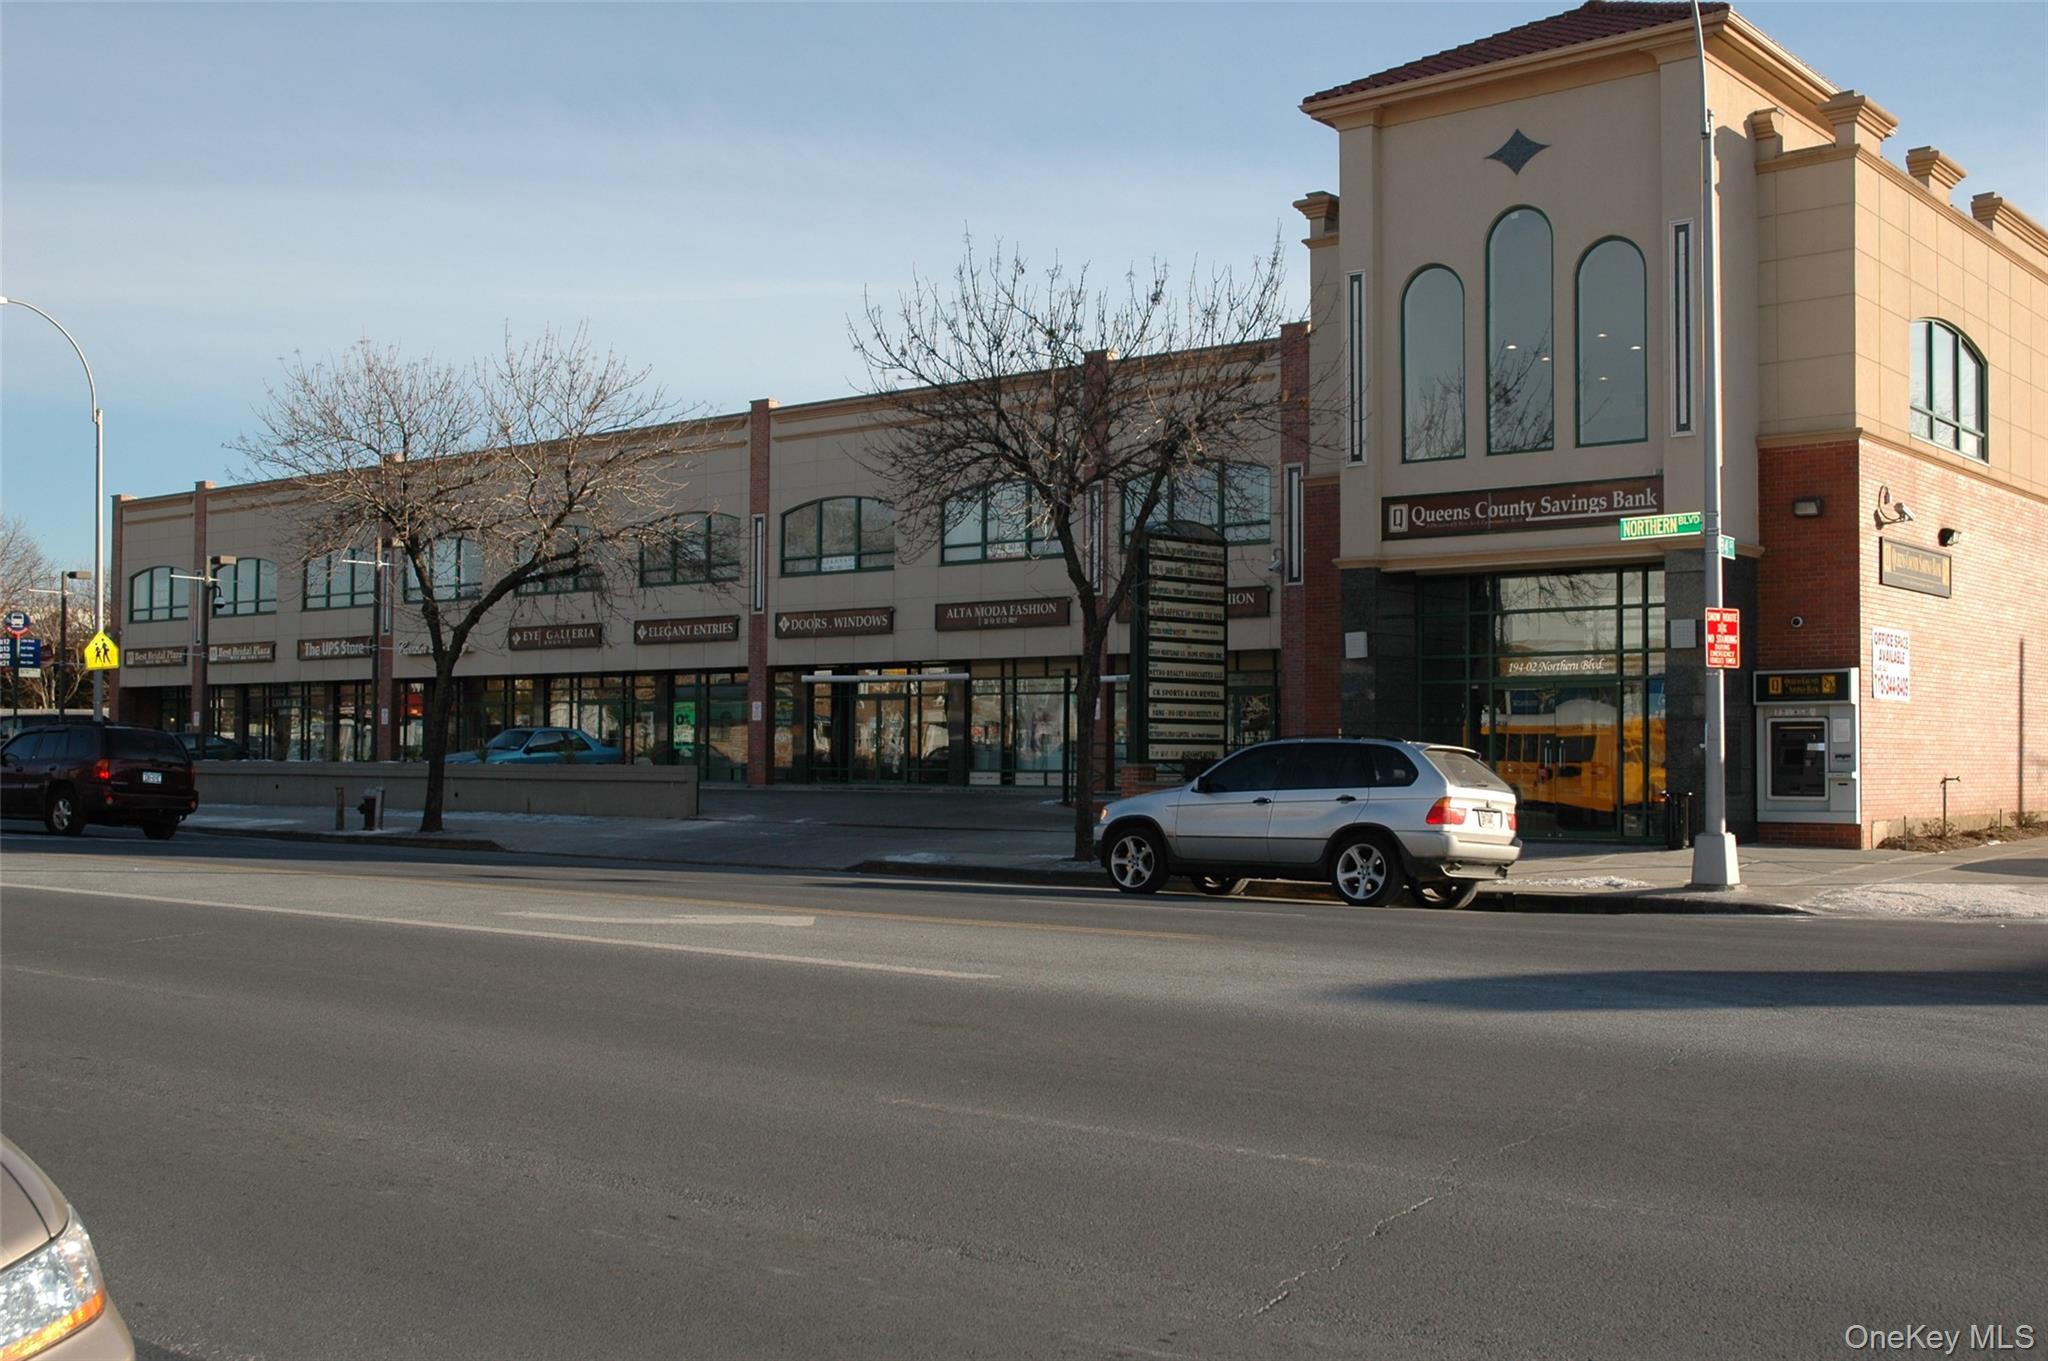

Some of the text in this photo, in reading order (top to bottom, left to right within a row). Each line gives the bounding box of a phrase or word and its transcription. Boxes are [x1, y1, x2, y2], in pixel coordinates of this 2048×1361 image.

[1411, 488, 1657, 526] Queens County Savings Bank
[1623, 514, 1700, 537] NORTHERN BLVD
[946, 602, 1057, 619] ALTA MODA FASHION
[649, 622, 734, 638] ELEGANT ENTRIES
[791, 614, 889, 631] DOORS WINDOWS
[523, 628, 595, 641] EYE GALLERIA
[1874, 631, 1909, 649] OFFICE SPACE
[218, 647, 231, 657] Best
[232, 646, 252, 656] Bridal
[253, 645, 270, 655] Plaza
[305, 640, 364, 656] The UPS Store
[1879, 648, 1905, 665] AVAILABLE
[1538, 658, 1579, 672] Northern
